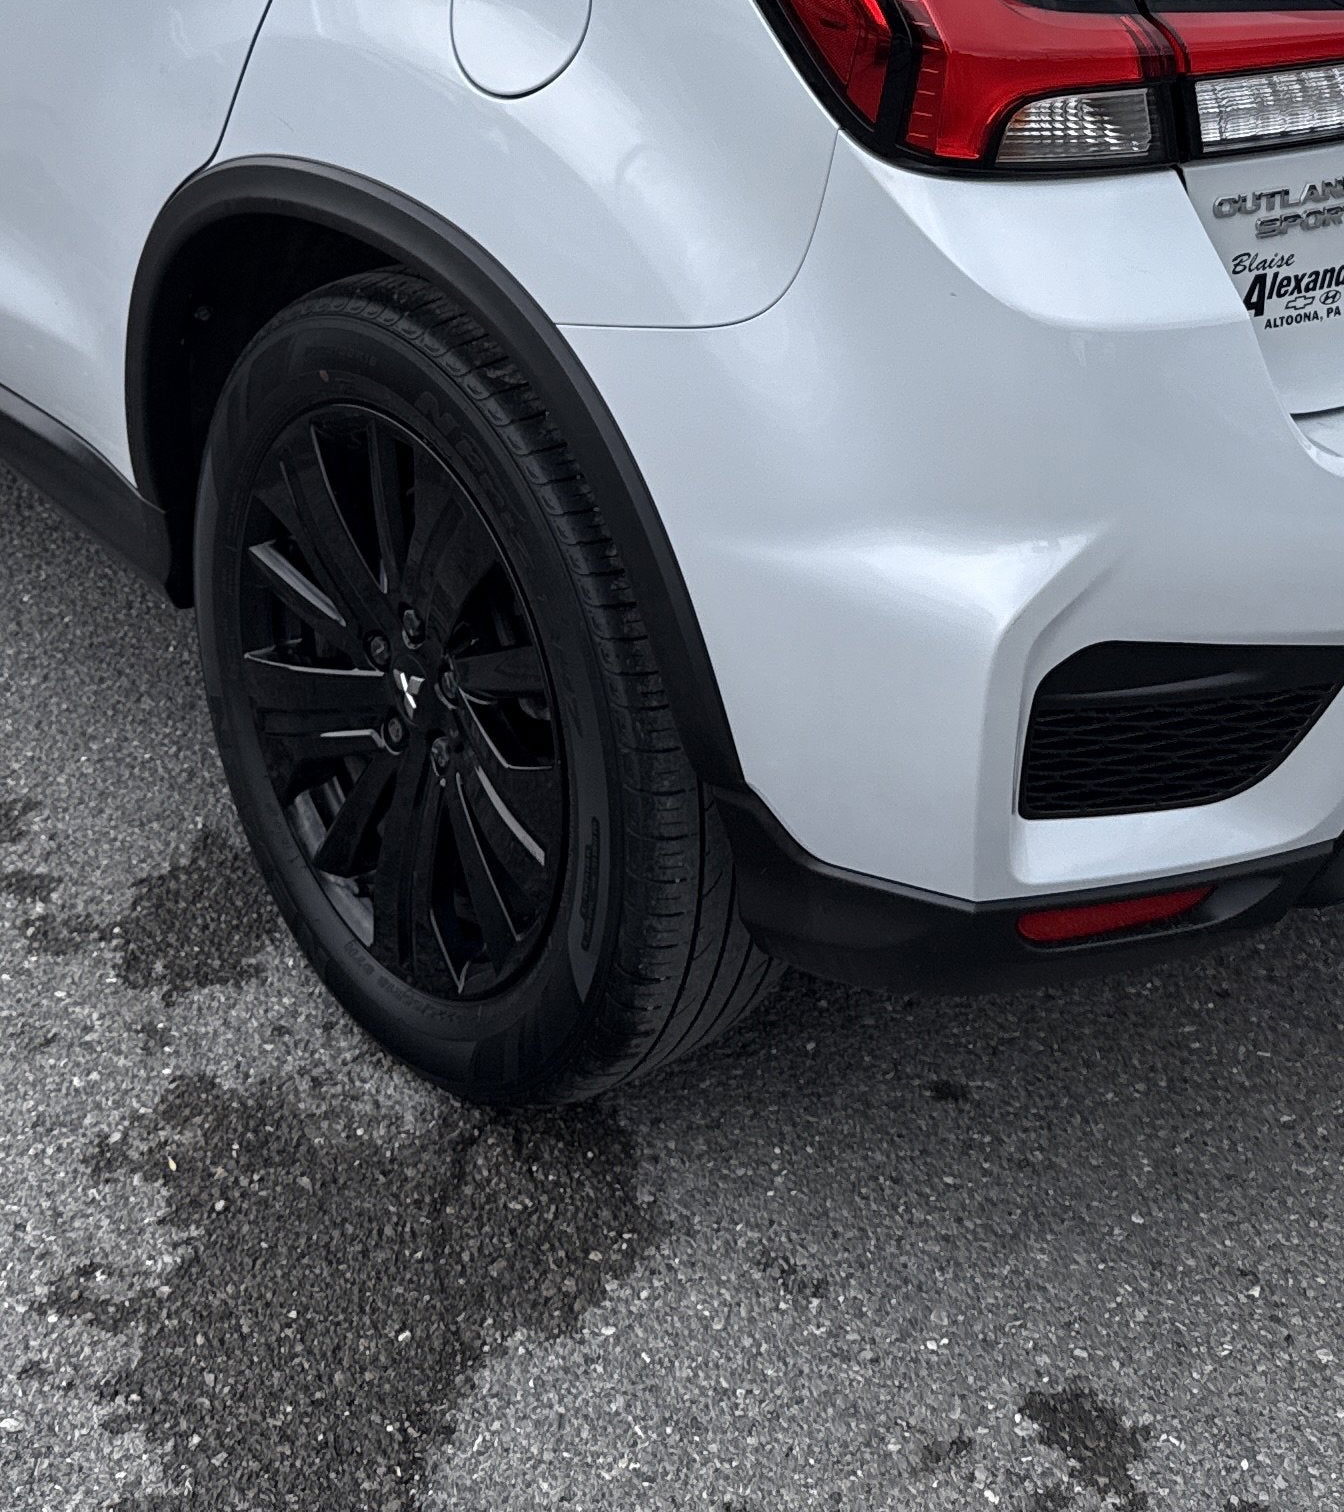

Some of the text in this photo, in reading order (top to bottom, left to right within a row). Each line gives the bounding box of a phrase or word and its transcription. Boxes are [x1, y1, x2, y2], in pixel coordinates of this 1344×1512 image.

[1231, 252, 1296, 275] Blaise
[1264, 305, 1342, 330] ALTOONA, PA
